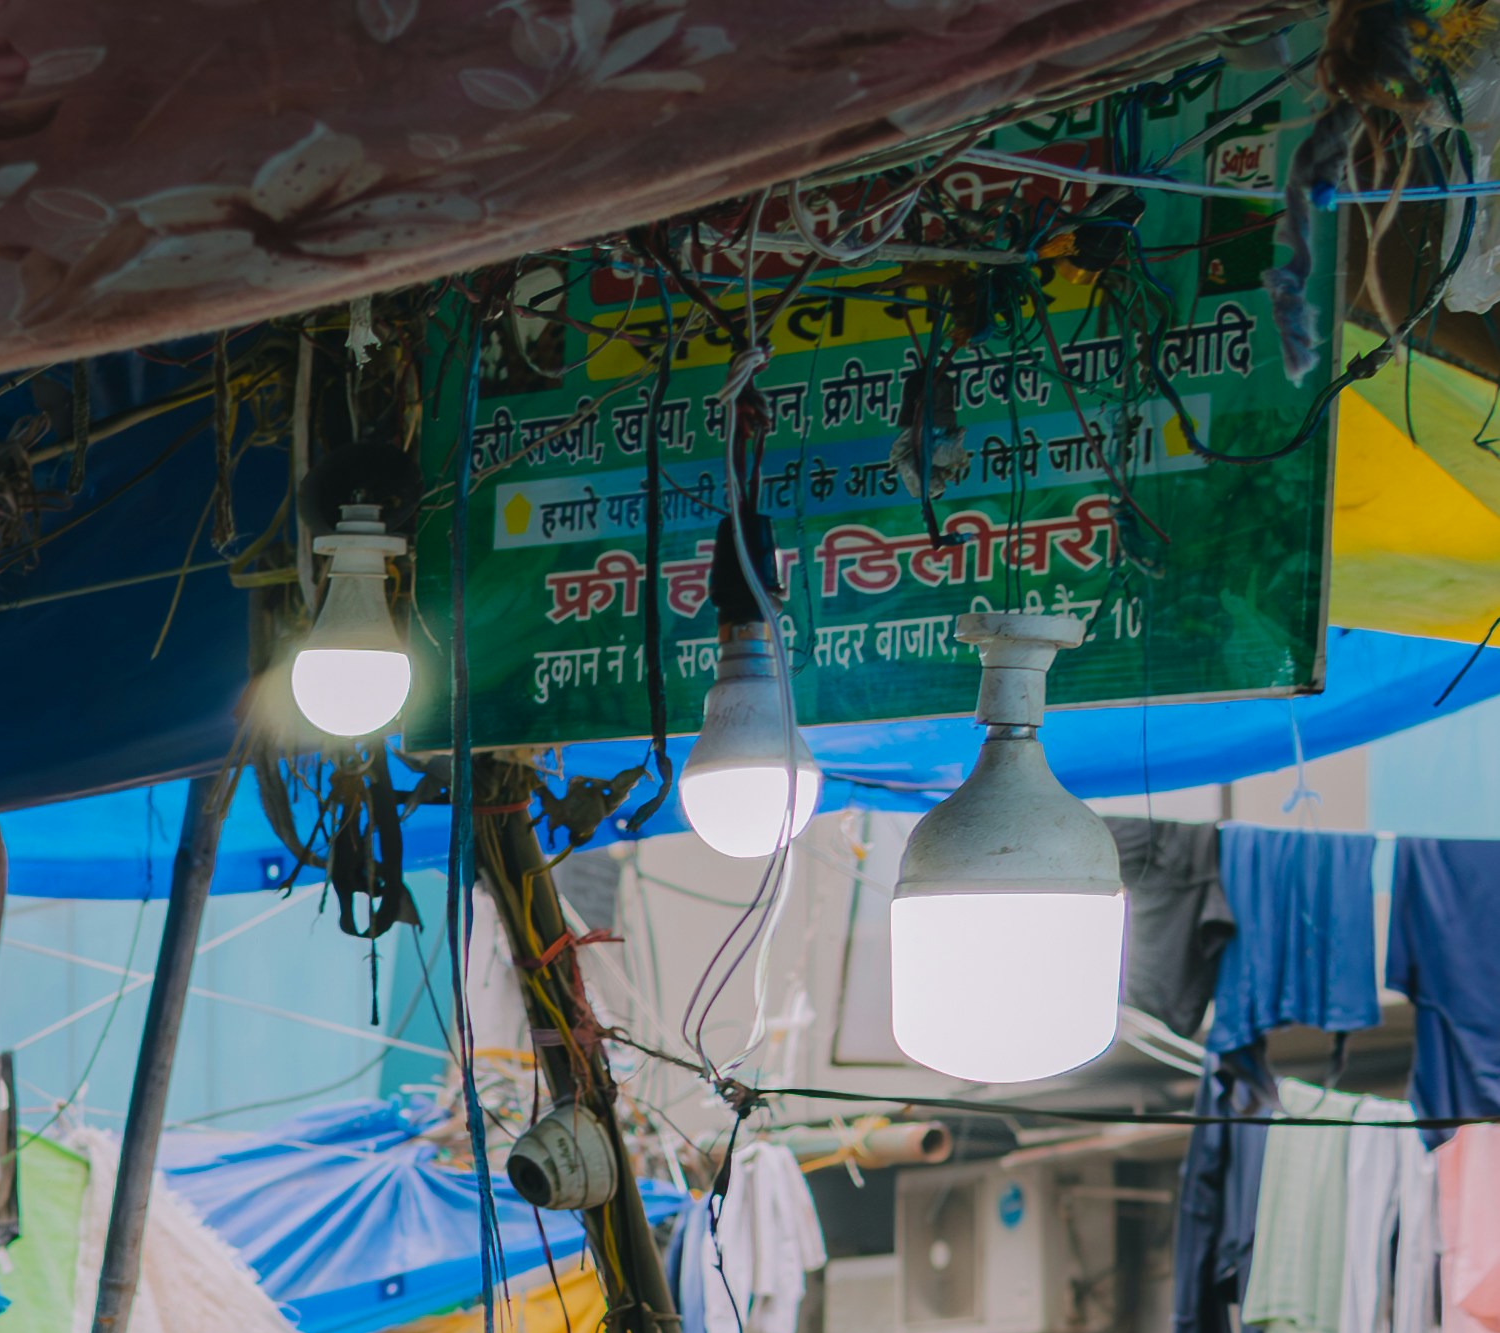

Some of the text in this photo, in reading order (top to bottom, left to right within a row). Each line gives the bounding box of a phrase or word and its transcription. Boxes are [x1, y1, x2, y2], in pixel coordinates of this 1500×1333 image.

[540, 485, 601, 538] हमारे
[810, 457, 837, 502] के
[544, 548, 648, 625] फ्री
[813, 494, 1124, 598] डिलीवरी
[532, 646, 601, 704] दुकान
[813, 622, 868, 670] सदर
